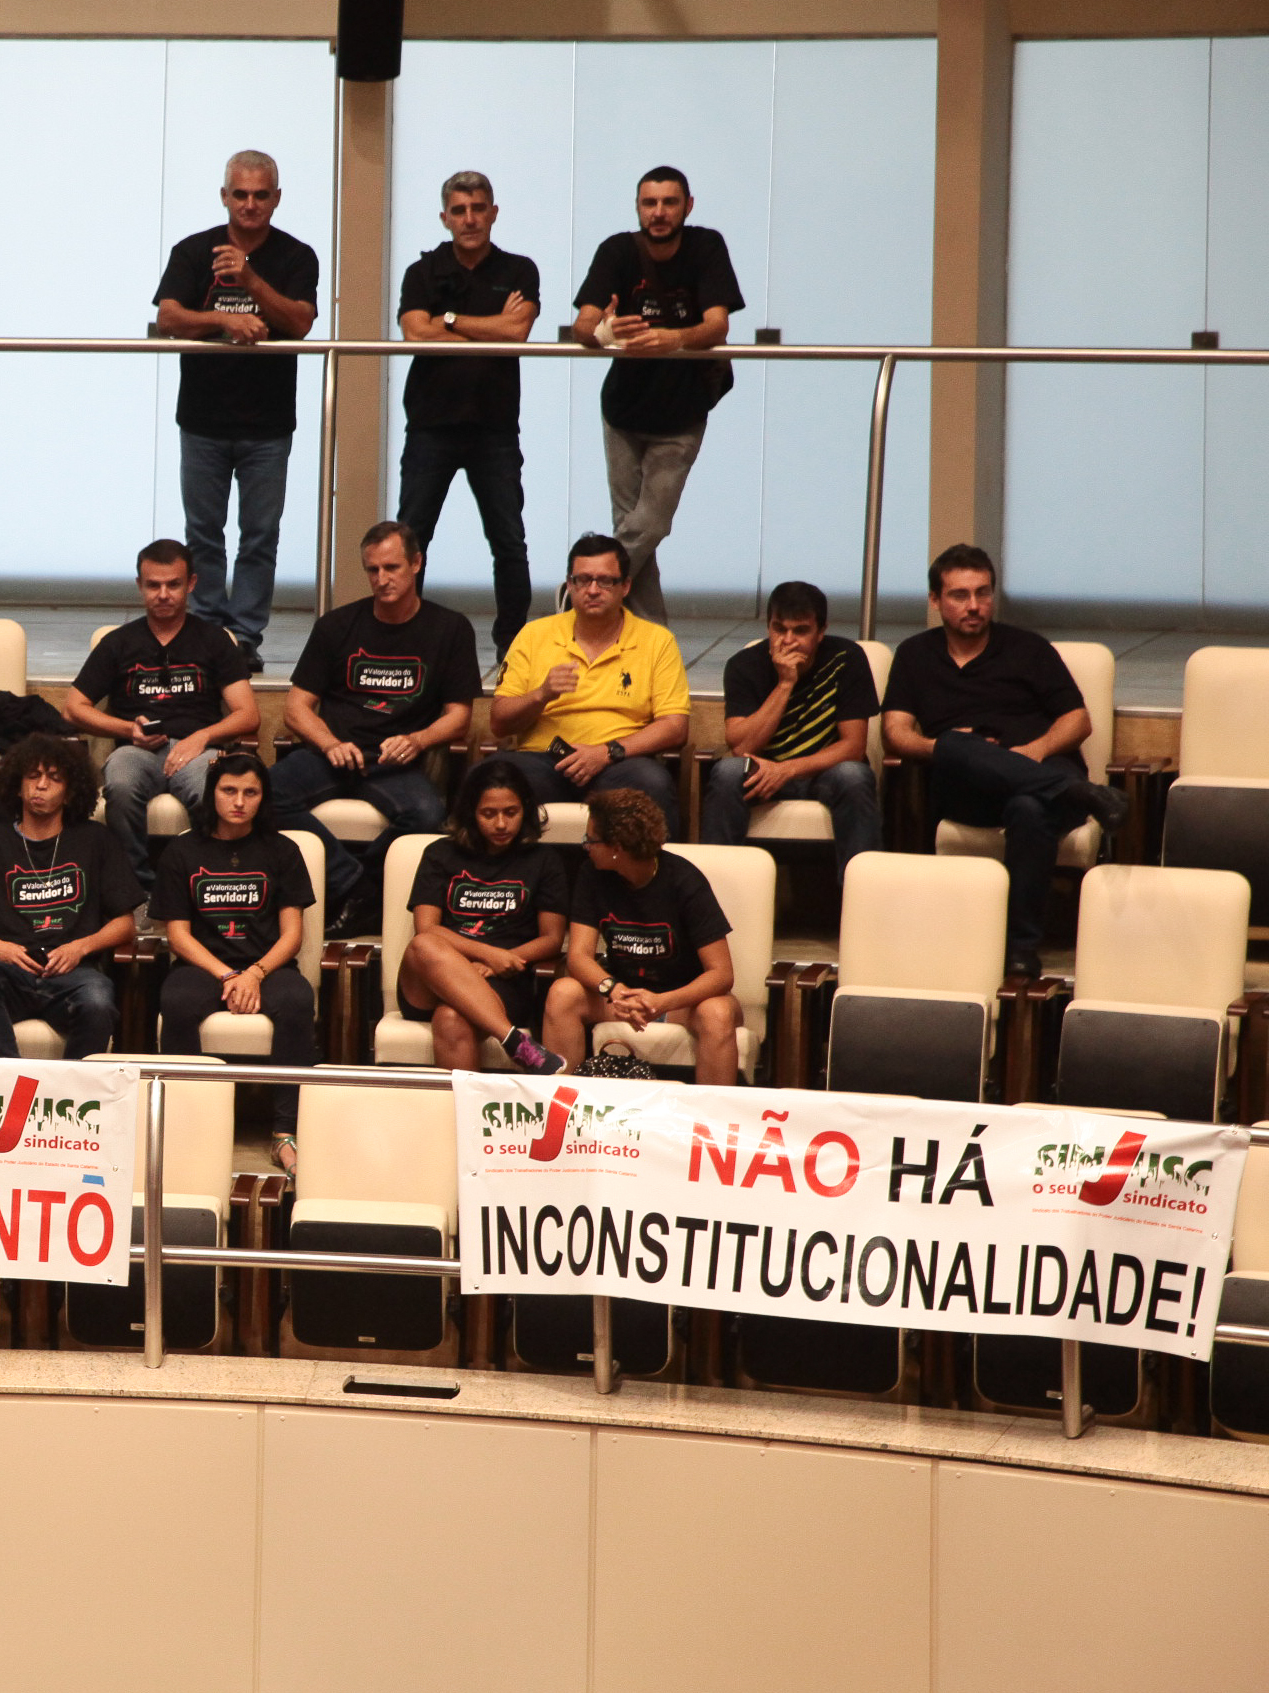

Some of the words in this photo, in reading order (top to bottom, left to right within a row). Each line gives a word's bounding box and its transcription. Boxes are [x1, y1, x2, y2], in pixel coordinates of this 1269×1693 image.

[214, 303, 252, 313] Servidor
[364, 668, 402, 677] #Valorização
[360, 675, 403, 687] Servidor
[404, 676, 413, 688] Já
[62, 876, 70, 884] do
[20, 886, 62, 900] Servidor
[64, 883, 73, 895] Já
[206, 884, 247, 892] #Valorização
[203, 891, 247, 903] Servidor
[249, 891, 258, 903] Já
[459, 898, 504, 909] Servidor
[505, 899, 516, 912] Já
[612, 940, 654, 955] Servidor
[655, 945, 665, 955] Já
[24, 1135, 100, 1152] sindicato
[484, 1144, 493, 1155] o
[499, 1143, 527, 1155] seu
[566, 1141, 640, 1159] sindicato
[688, 1109, 861, 1198] NÃO
[888, 1124, 994, 1207] HÁ
[1032, 1183, 1044, 1195] o
[1049, 1182, 1077, 1195] seu
[1123, 1190, 1207, 1214] sindicato
[481, 1205, 1206, 1338] INCONSTITUCIONALIDADE!
